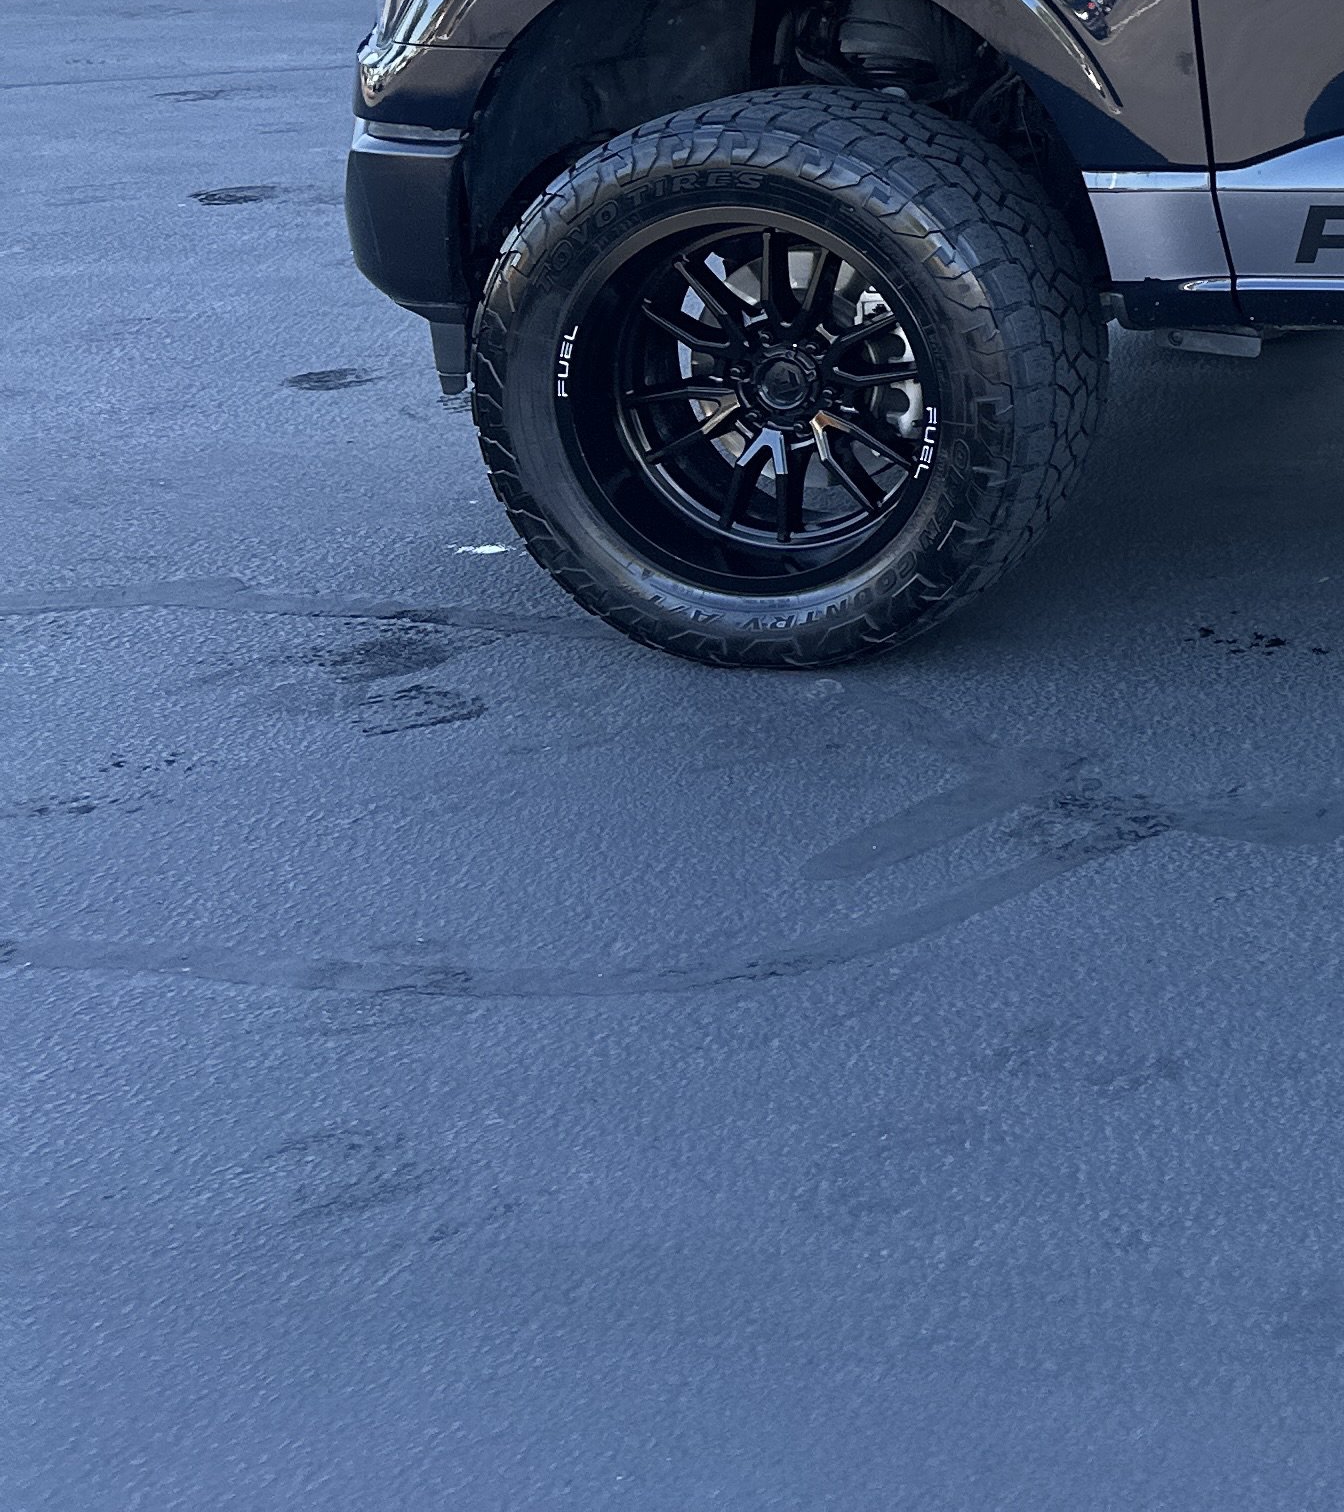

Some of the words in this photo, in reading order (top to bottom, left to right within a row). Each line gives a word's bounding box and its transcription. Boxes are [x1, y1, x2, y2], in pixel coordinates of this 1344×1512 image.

[532, 198, 620, 294] TOYO
[623, 170, 767, 207] TIRES
[557, 325, 579, 398] FUEL
[913, 406, 938, 479] FUEL
